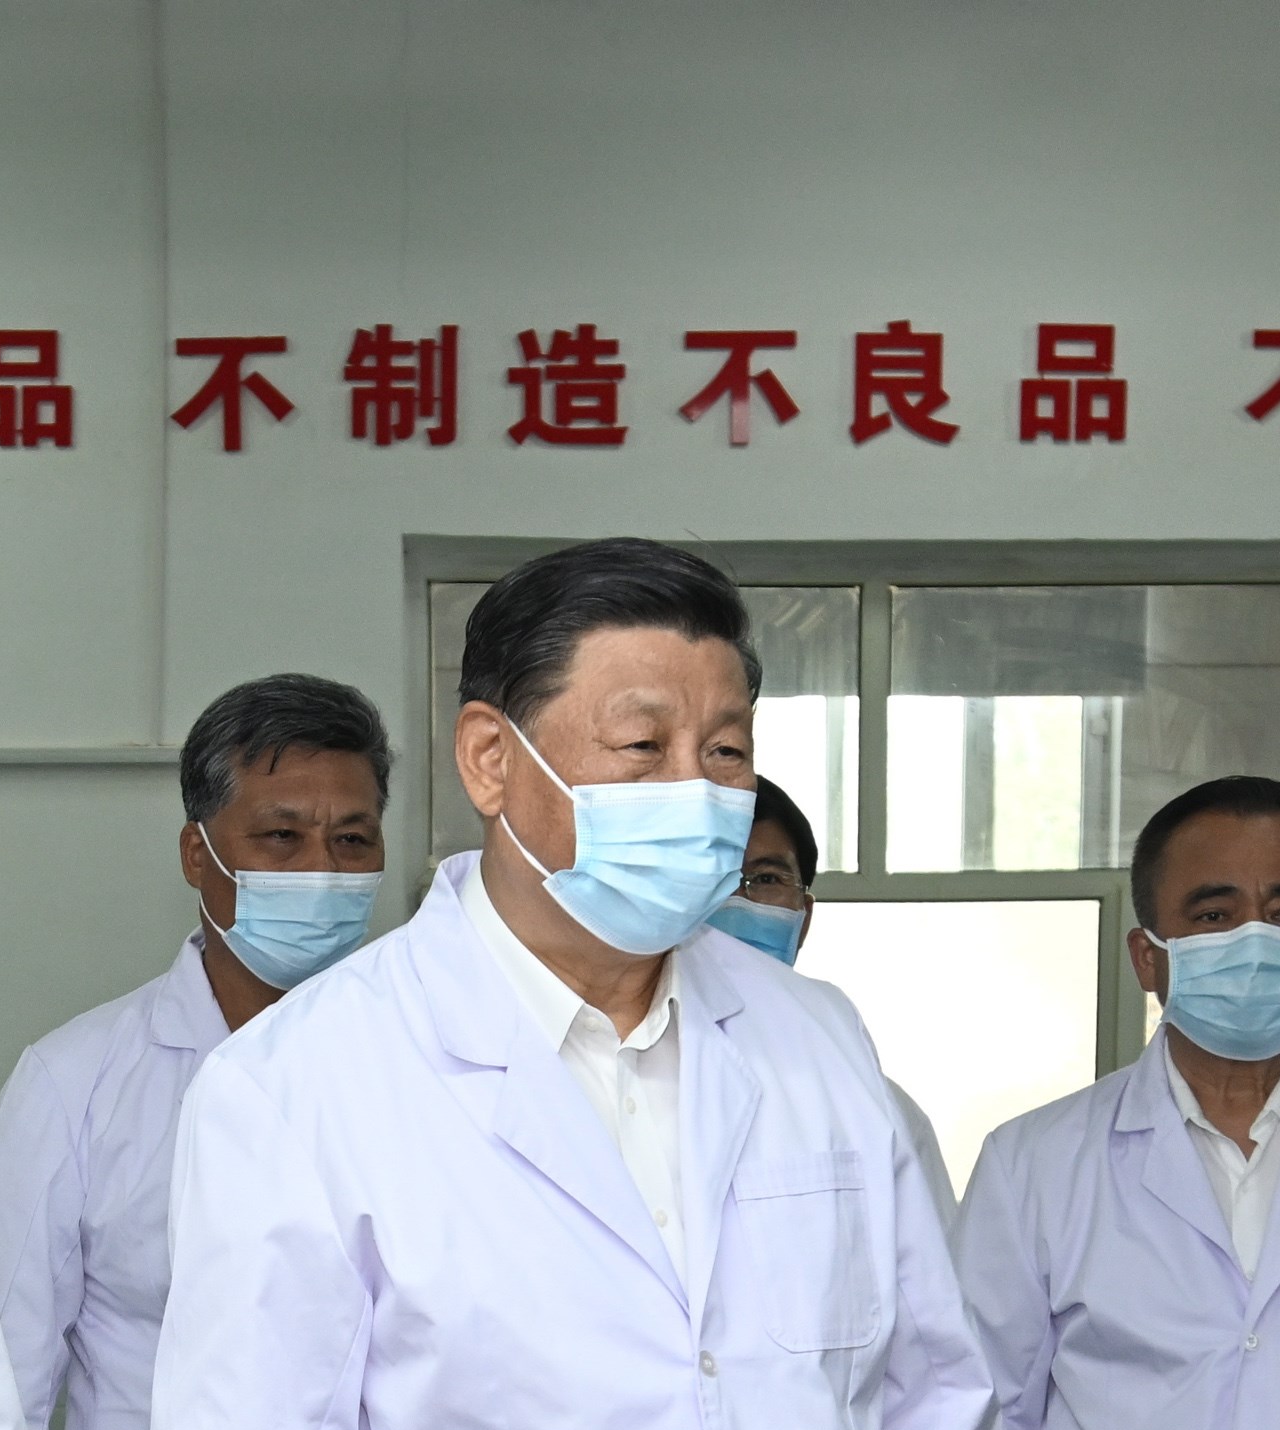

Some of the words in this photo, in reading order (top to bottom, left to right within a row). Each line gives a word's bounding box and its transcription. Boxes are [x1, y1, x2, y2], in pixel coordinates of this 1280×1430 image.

[170, 319, 1129, 452] 不制造不良品
